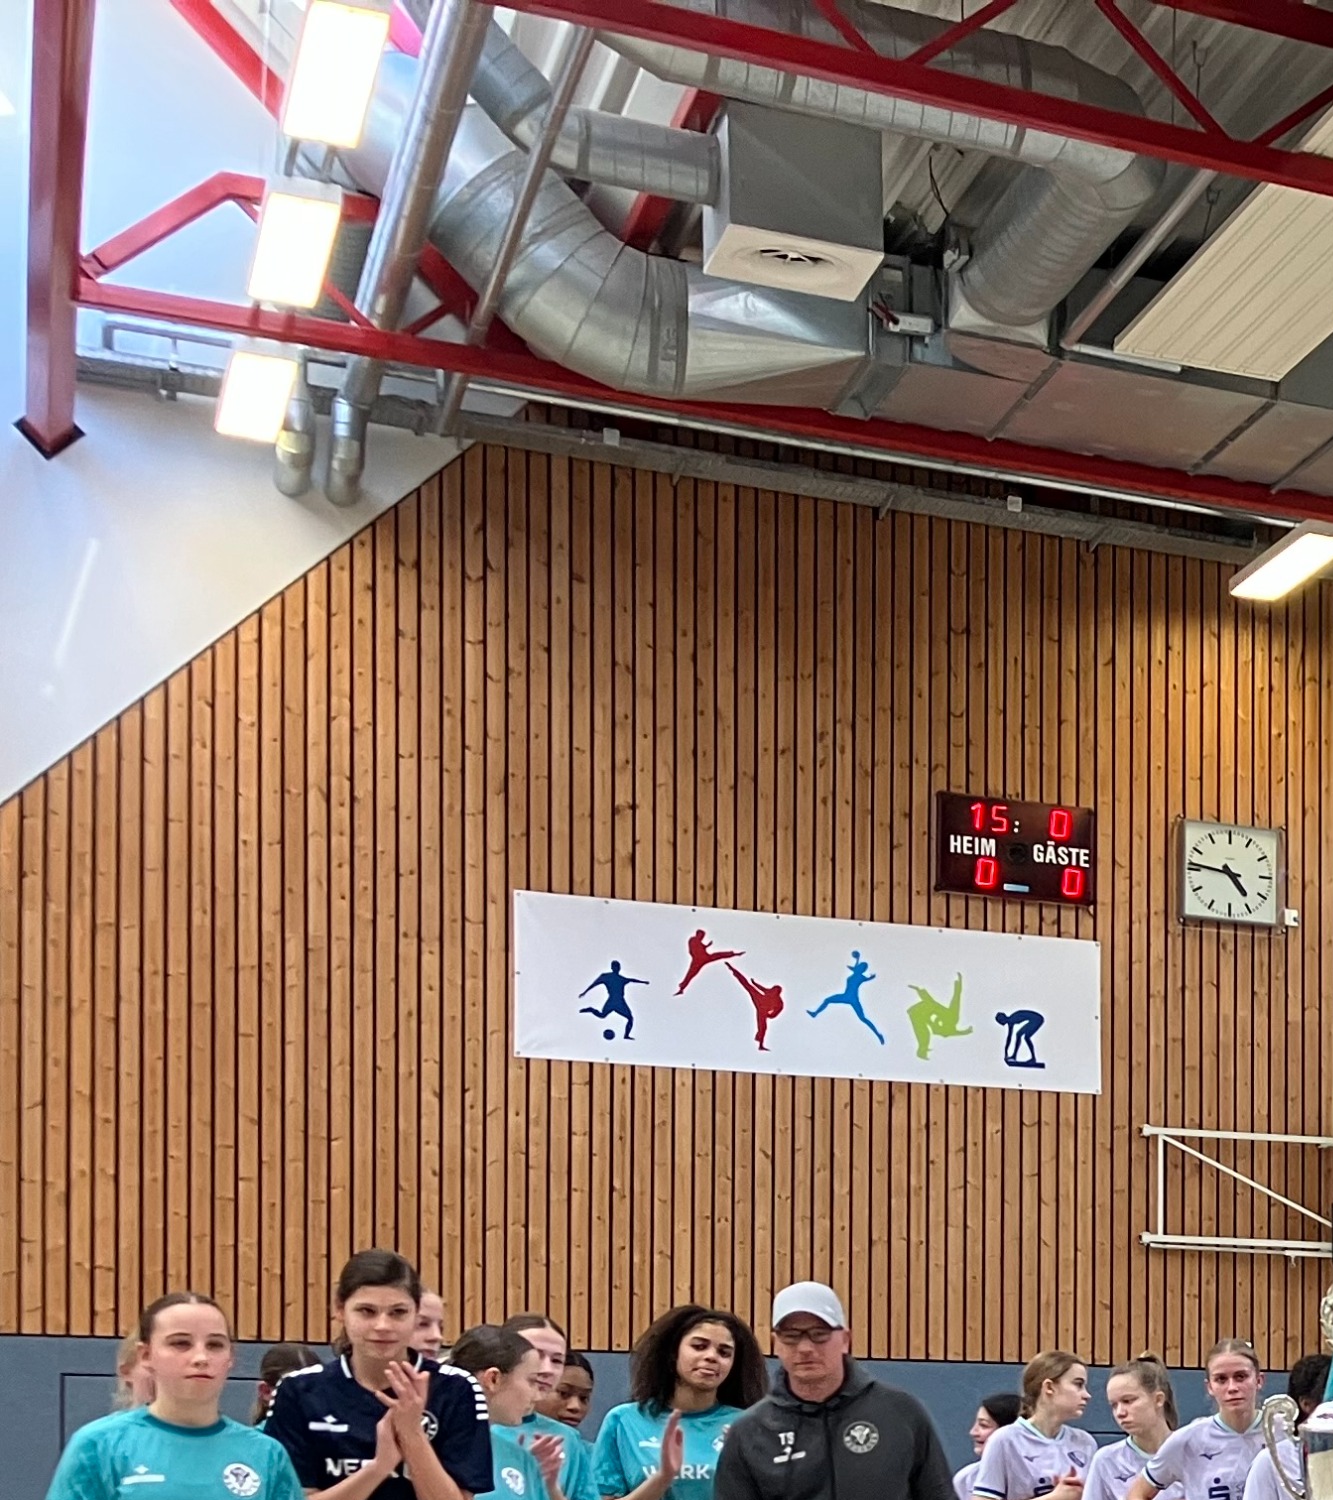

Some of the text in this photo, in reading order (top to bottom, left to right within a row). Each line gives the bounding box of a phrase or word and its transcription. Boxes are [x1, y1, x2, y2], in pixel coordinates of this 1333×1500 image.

[950, 834, 1091, 868] HEIM GÄSTE
[975, 857, 1081, 896] 0 0
[778, 1431, 796, 1446] TS
